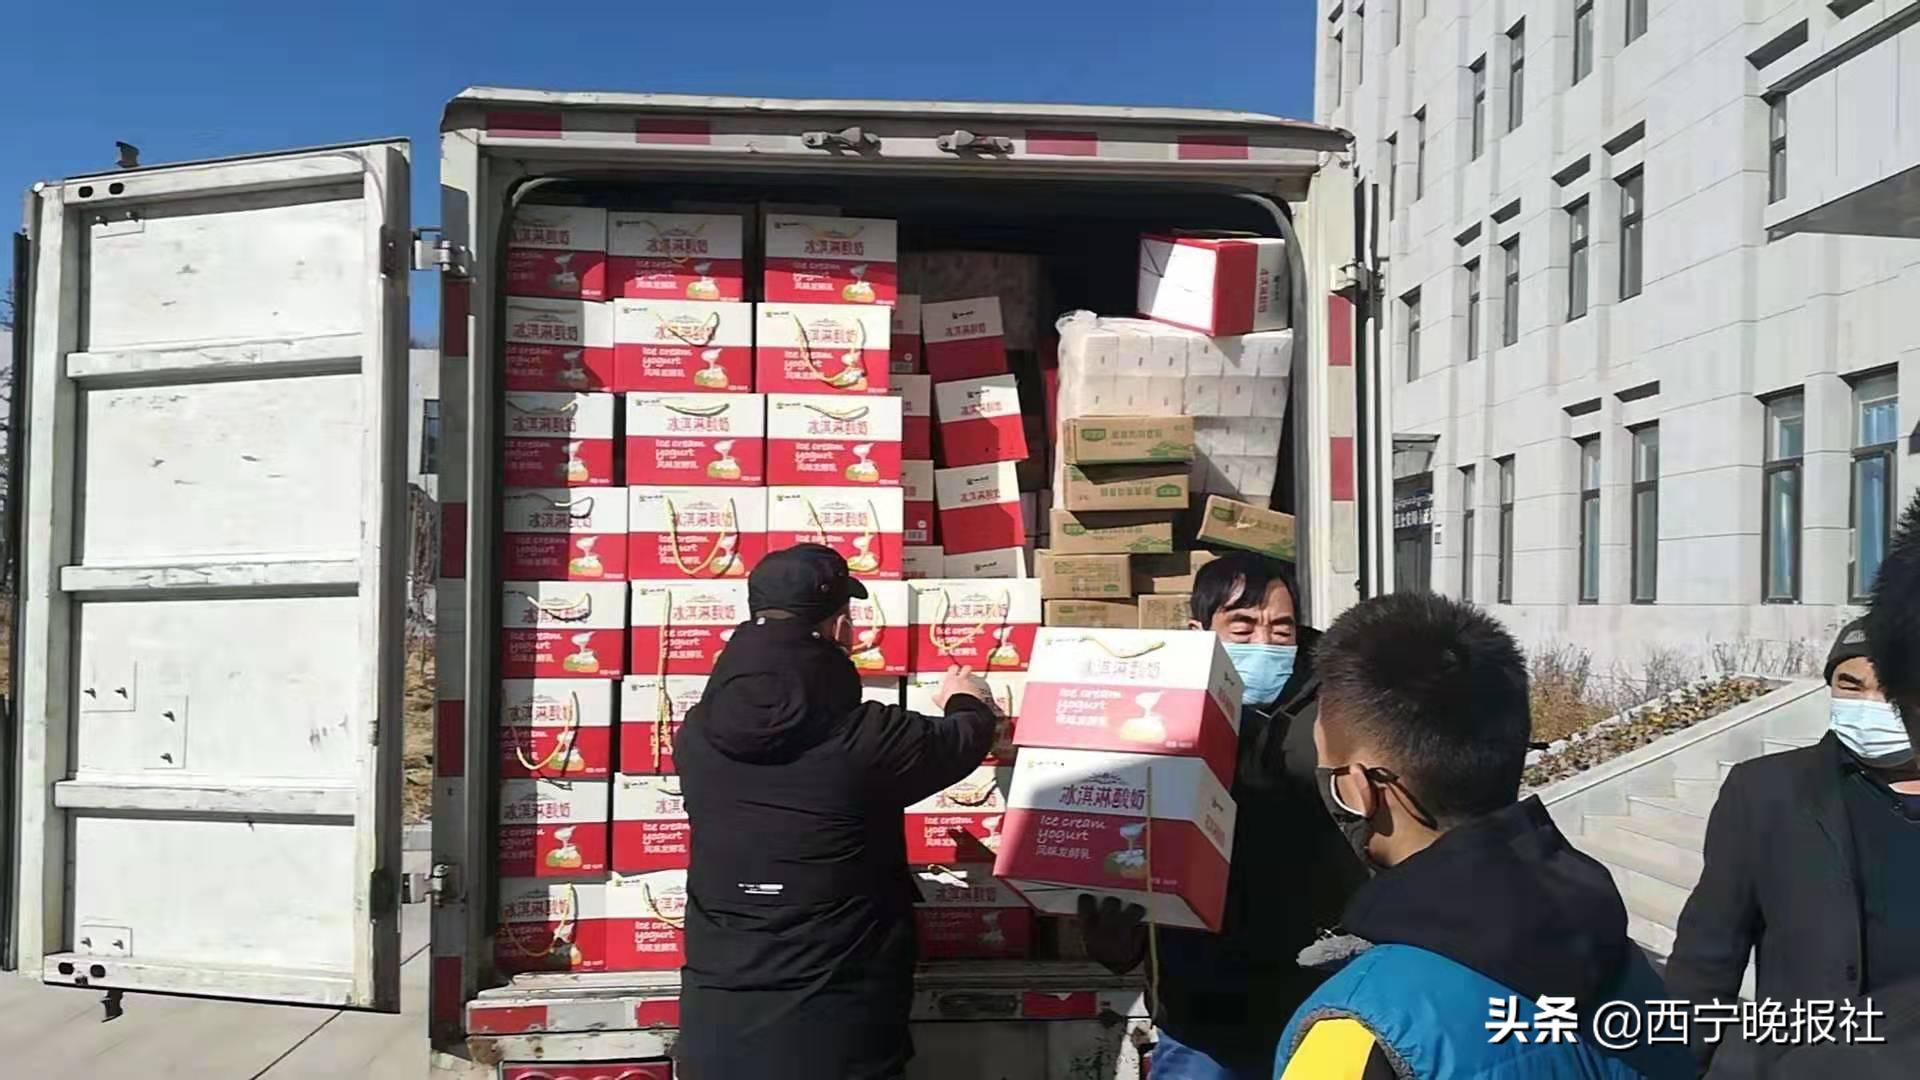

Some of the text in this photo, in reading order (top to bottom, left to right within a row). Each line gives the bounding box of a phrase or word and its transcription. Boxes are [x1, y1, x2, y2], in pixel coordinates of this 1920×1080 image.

[1060, 784, 1147, 811] 冰淇淋酸奶
[1040, 815, 1107, 830] Ice cream
[1036, 828, 1089, 844] yogurt
